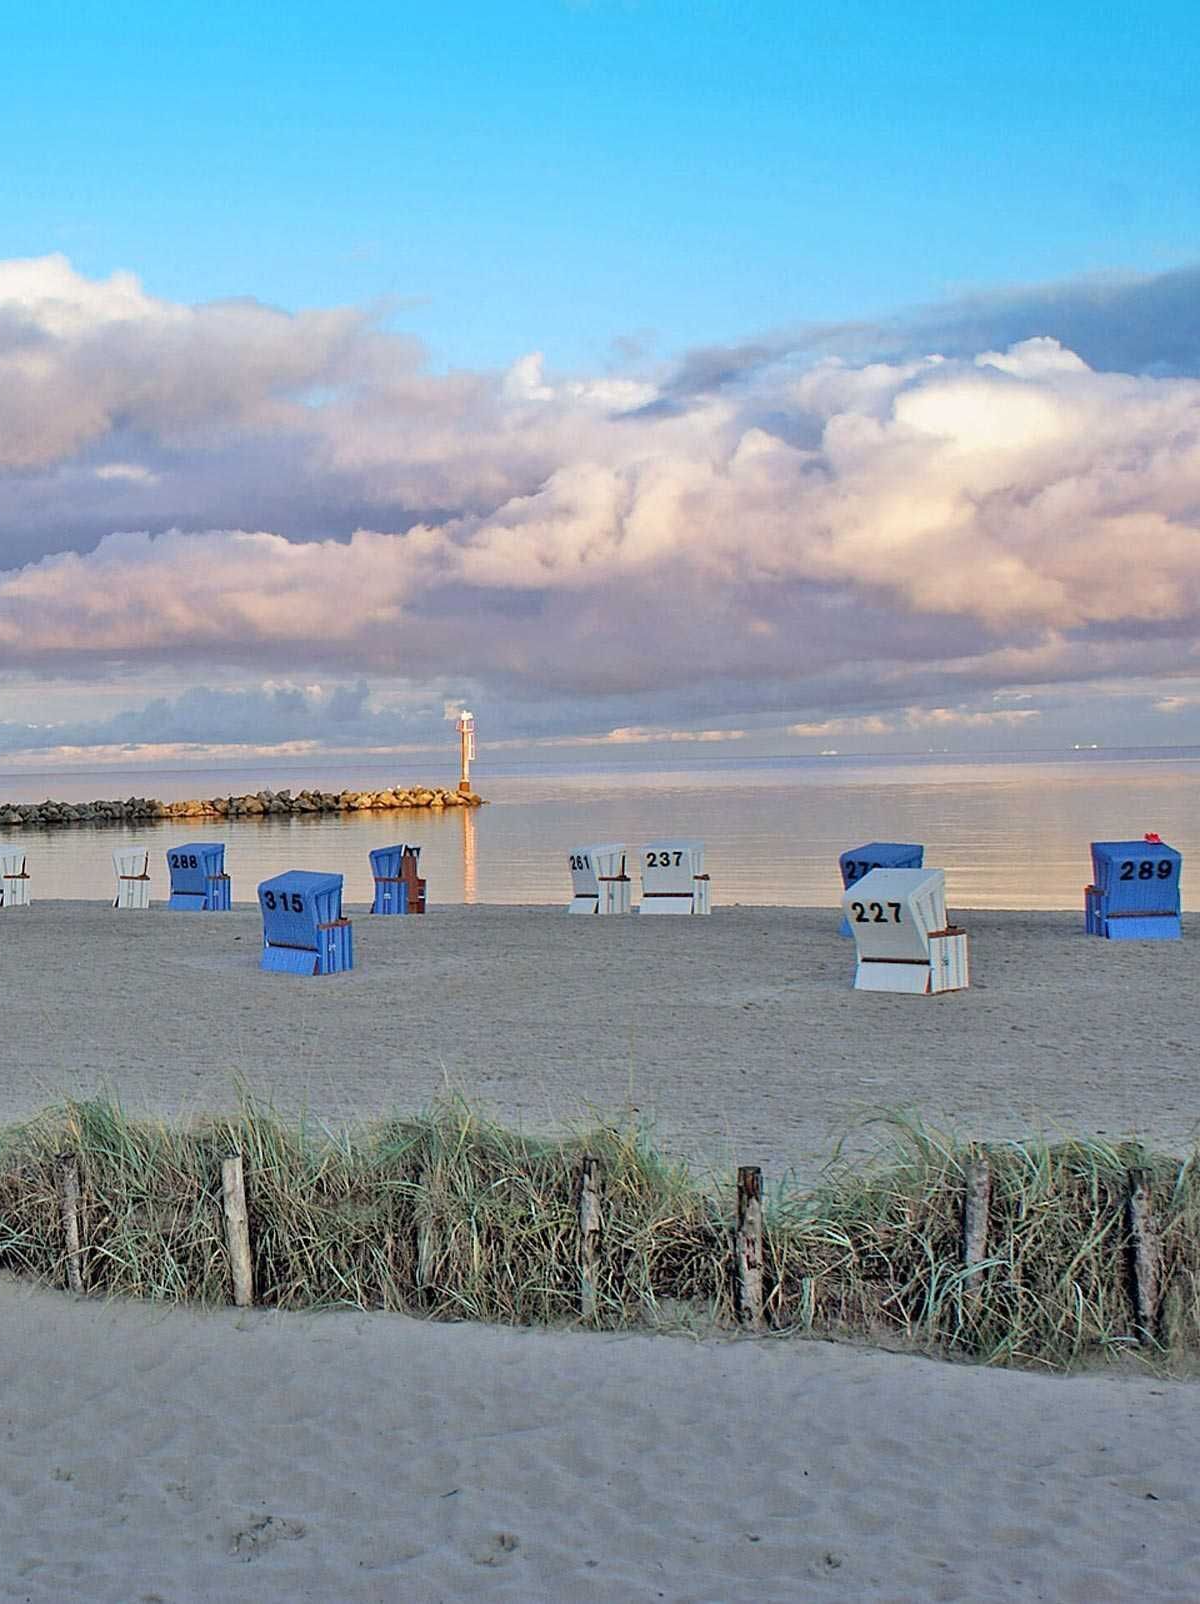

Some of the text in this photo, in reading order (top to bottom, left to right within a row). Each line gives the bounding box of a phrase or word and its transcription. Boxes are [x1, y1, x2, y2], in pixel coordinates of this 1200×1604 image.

[171, 854, 198, 869] 288
[569, 855, 590, 871] 261
[646, 851, 683, 868] 237
[1120, 860, 1172, 881] 289
[264, 890, 304, 913] 315
[851, 902, 902, 923] 227
